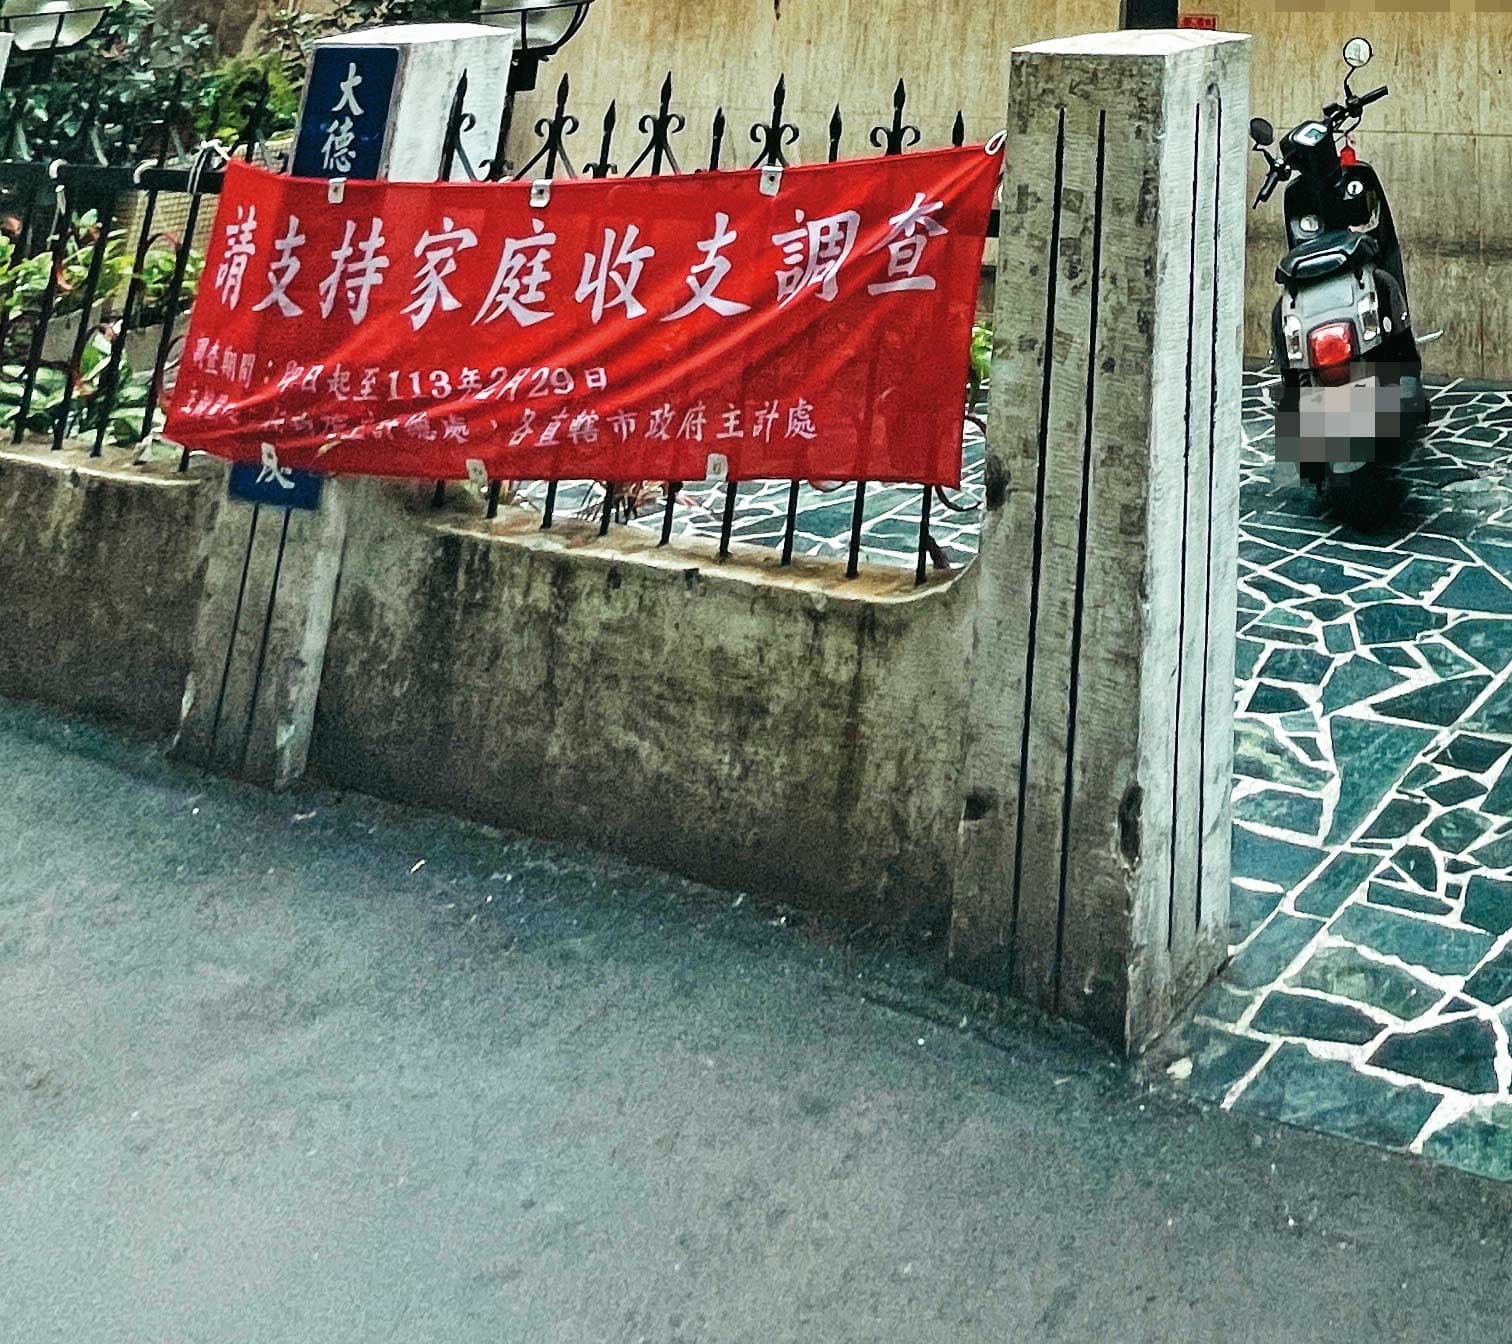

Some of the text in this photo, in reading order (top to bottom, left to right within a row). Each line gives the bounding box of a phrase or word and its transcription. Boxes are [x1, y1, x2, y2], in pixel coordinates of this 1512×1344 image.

[321, 62, 365, 173] 大德
[214, 192, 950, 331] 請支持家庭收支調查
